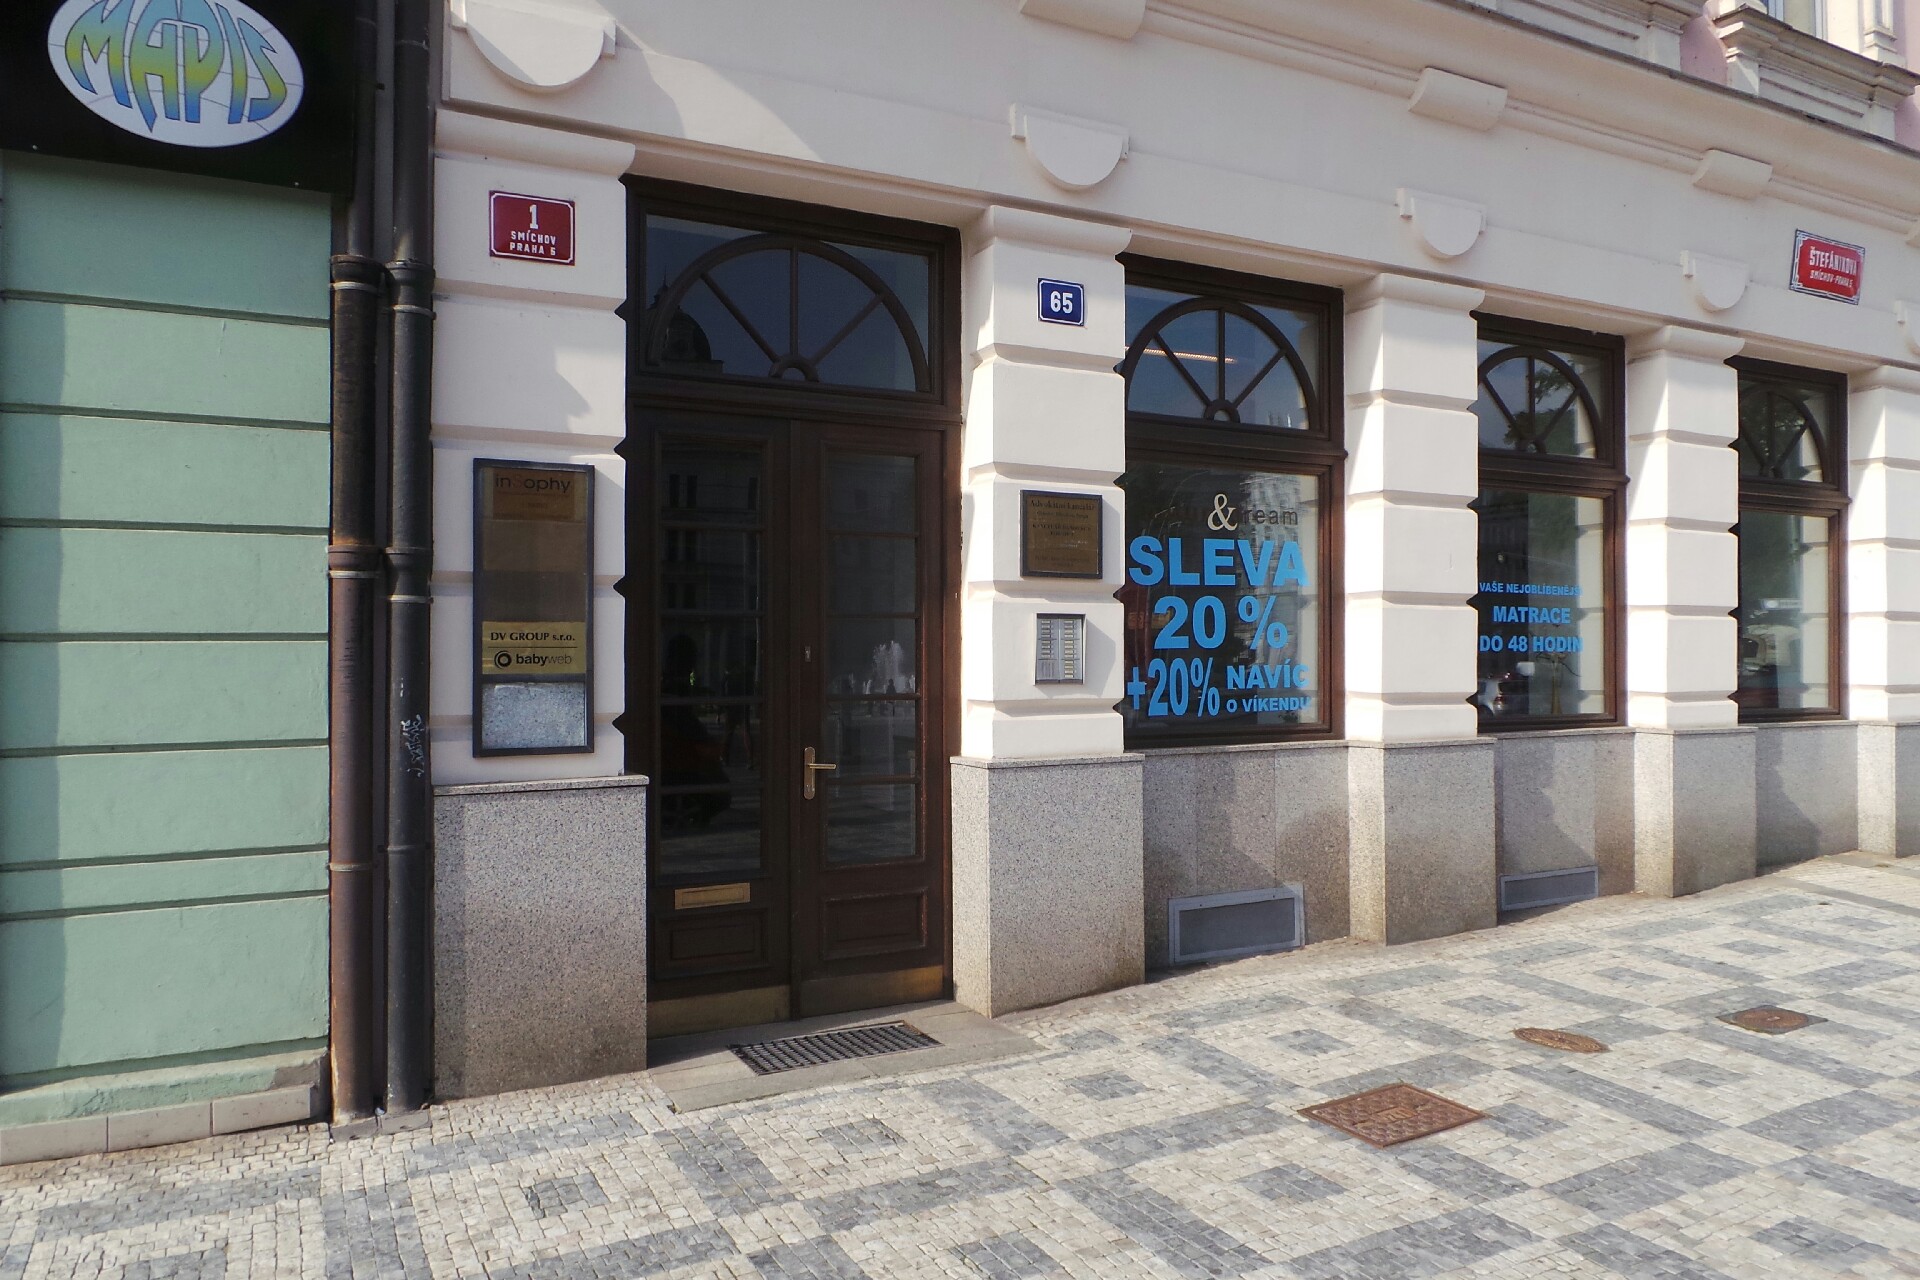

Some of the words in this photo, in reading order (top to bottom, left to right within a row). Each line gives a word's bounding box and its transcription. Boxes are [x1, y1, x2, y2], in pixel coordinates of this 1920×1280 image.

[65, 0, 287, 132] MAPIS
[529, 204, 539, 229] 1
[511, 230, 556, 245] SMÍCHOV
[509, 242, 545, 255] PRAHA
[550, 246, 556, 256] 5
[1050, 291, 1073, 314] 65
[1128, 535, 1309, 587] SLEVA
[1479, 581, 1504, 593] VAŠE
[1493, 605, 1571, 624] MATRACE
[490, 632, 506, 641] DV
[509, 632, 550, 641] GROUP
[552, 633, 576, 641] s.r.o.
[1479, 635, 1503, 652] DO
[1508, 635, 1528, 652] 48
[1532, 636, 1584, 653] HODIN
[1127, 657, 1221, 717] +20%
[1226, 658, 1309, 690] NAVÍC
[1241, 696, 1311, 713] VÍKENDU
